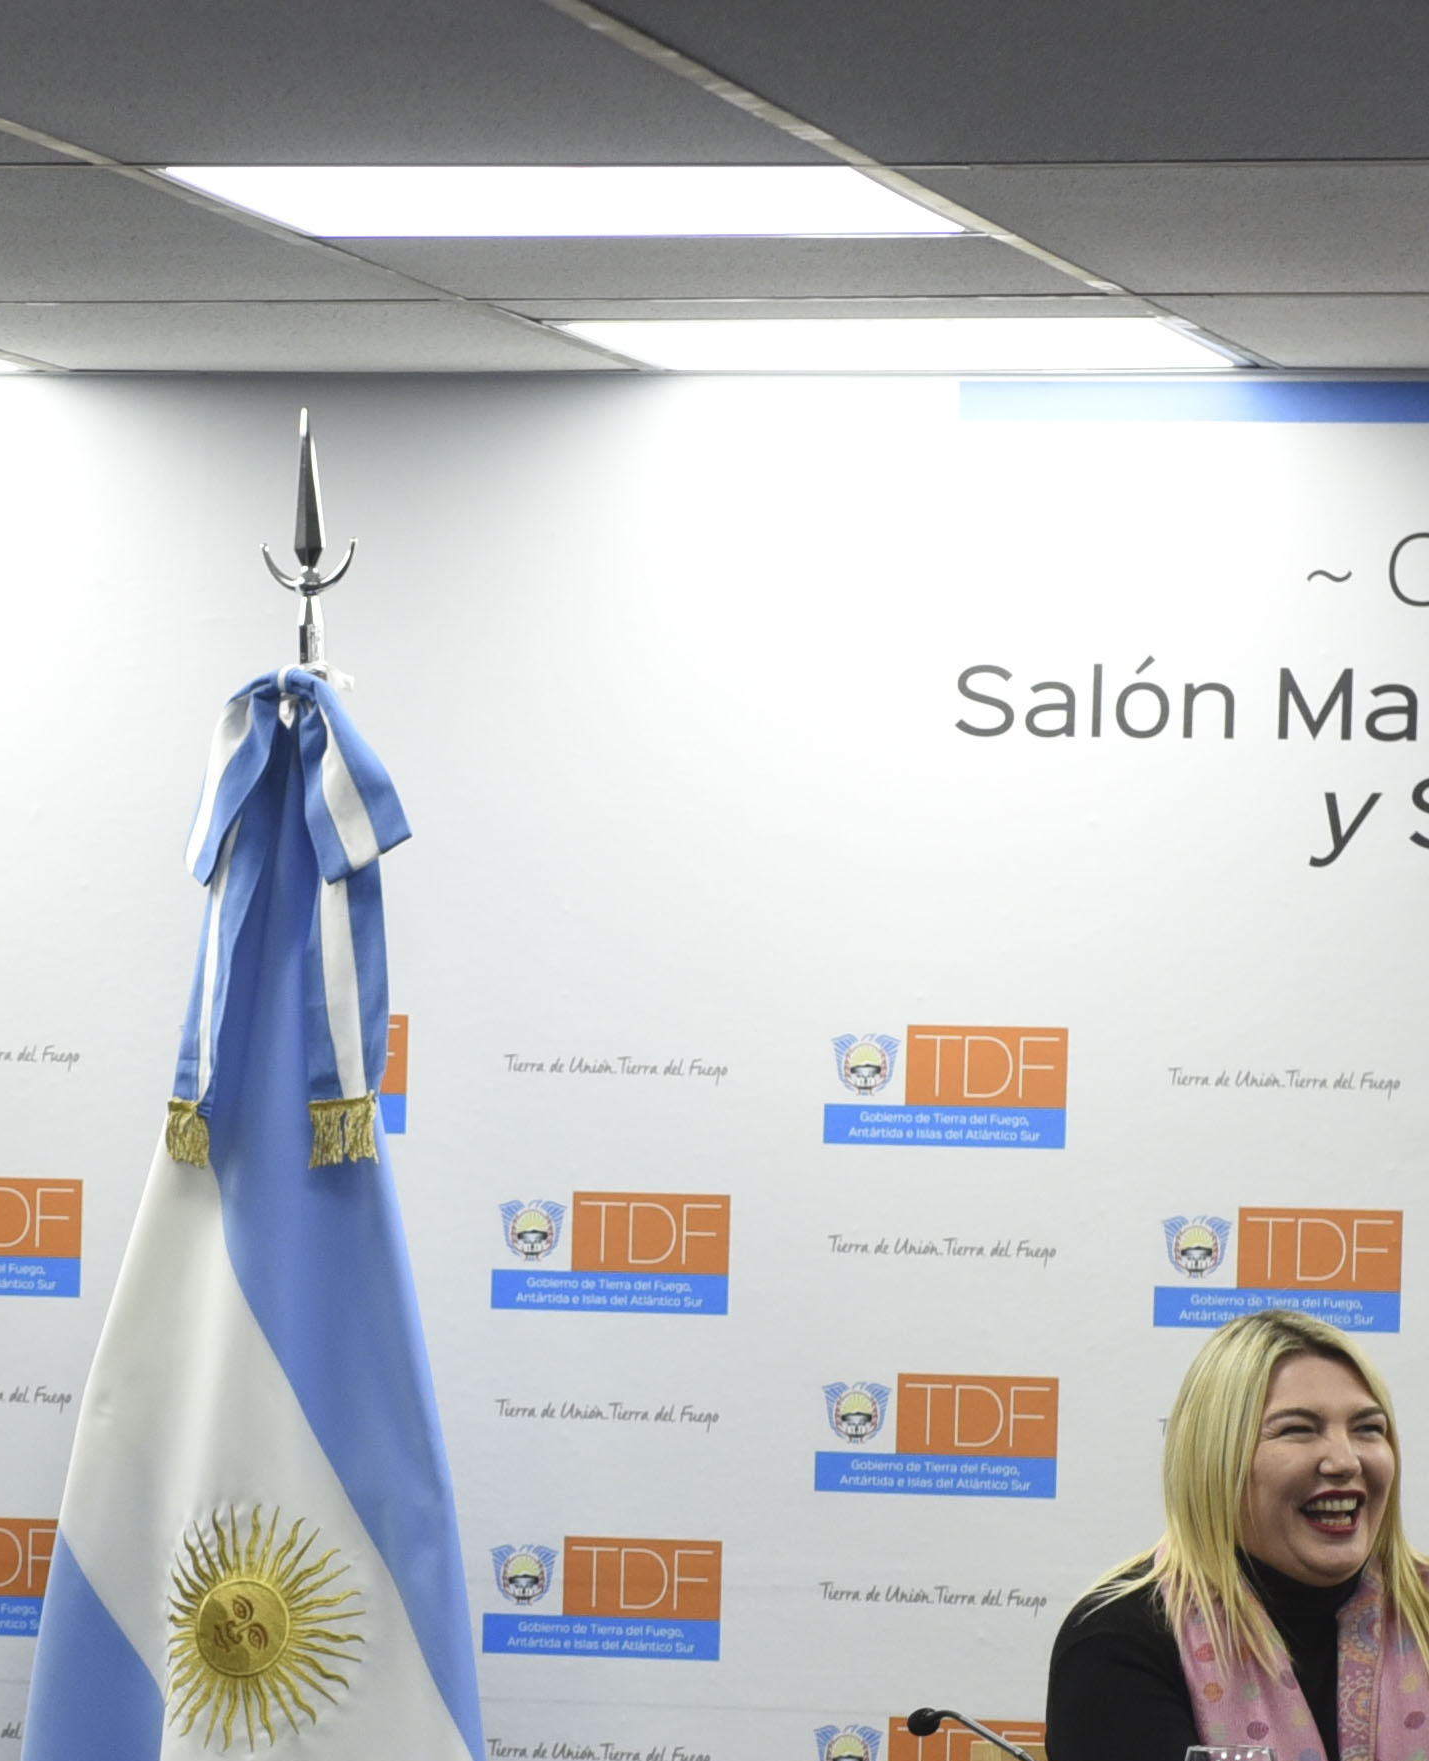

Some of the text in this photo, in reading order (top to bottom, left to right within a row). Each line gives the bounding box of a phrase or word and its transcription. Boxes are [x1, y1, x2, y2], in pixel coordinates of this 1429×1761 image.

[955, 656, 1235, 739] Salón
[1309, 792, 1382, 868] y
[504, 1054, 544, 1072] Tierra
[549, 1057, 564, 1073] de
[617, 1056, 658, 1075] Tierra
[663, 1058, 683, 1077] del
[688, 1059, 728, 1088] Fuego
[914, 1033, 1061, 1099] TDF
[579, 1200, 724, 1266] TDF
[1246, 1216, 1395, 1282] TDF
[9, 1385, 28, 1403] del
[33, 1386, 72, 1415] Fuego
[904, 1382, 1052, 1449] TDF
[571, 1545, 715, 1611] TDF
[819, 1581, 860, 1600] Tierra
[865, 1585, 880, 1602] de
[934, 1585, 976, 1604] Tierra
[981, 1587, 1001, 1606] del
[1007, 1589, 1047, 1618] Fuego
